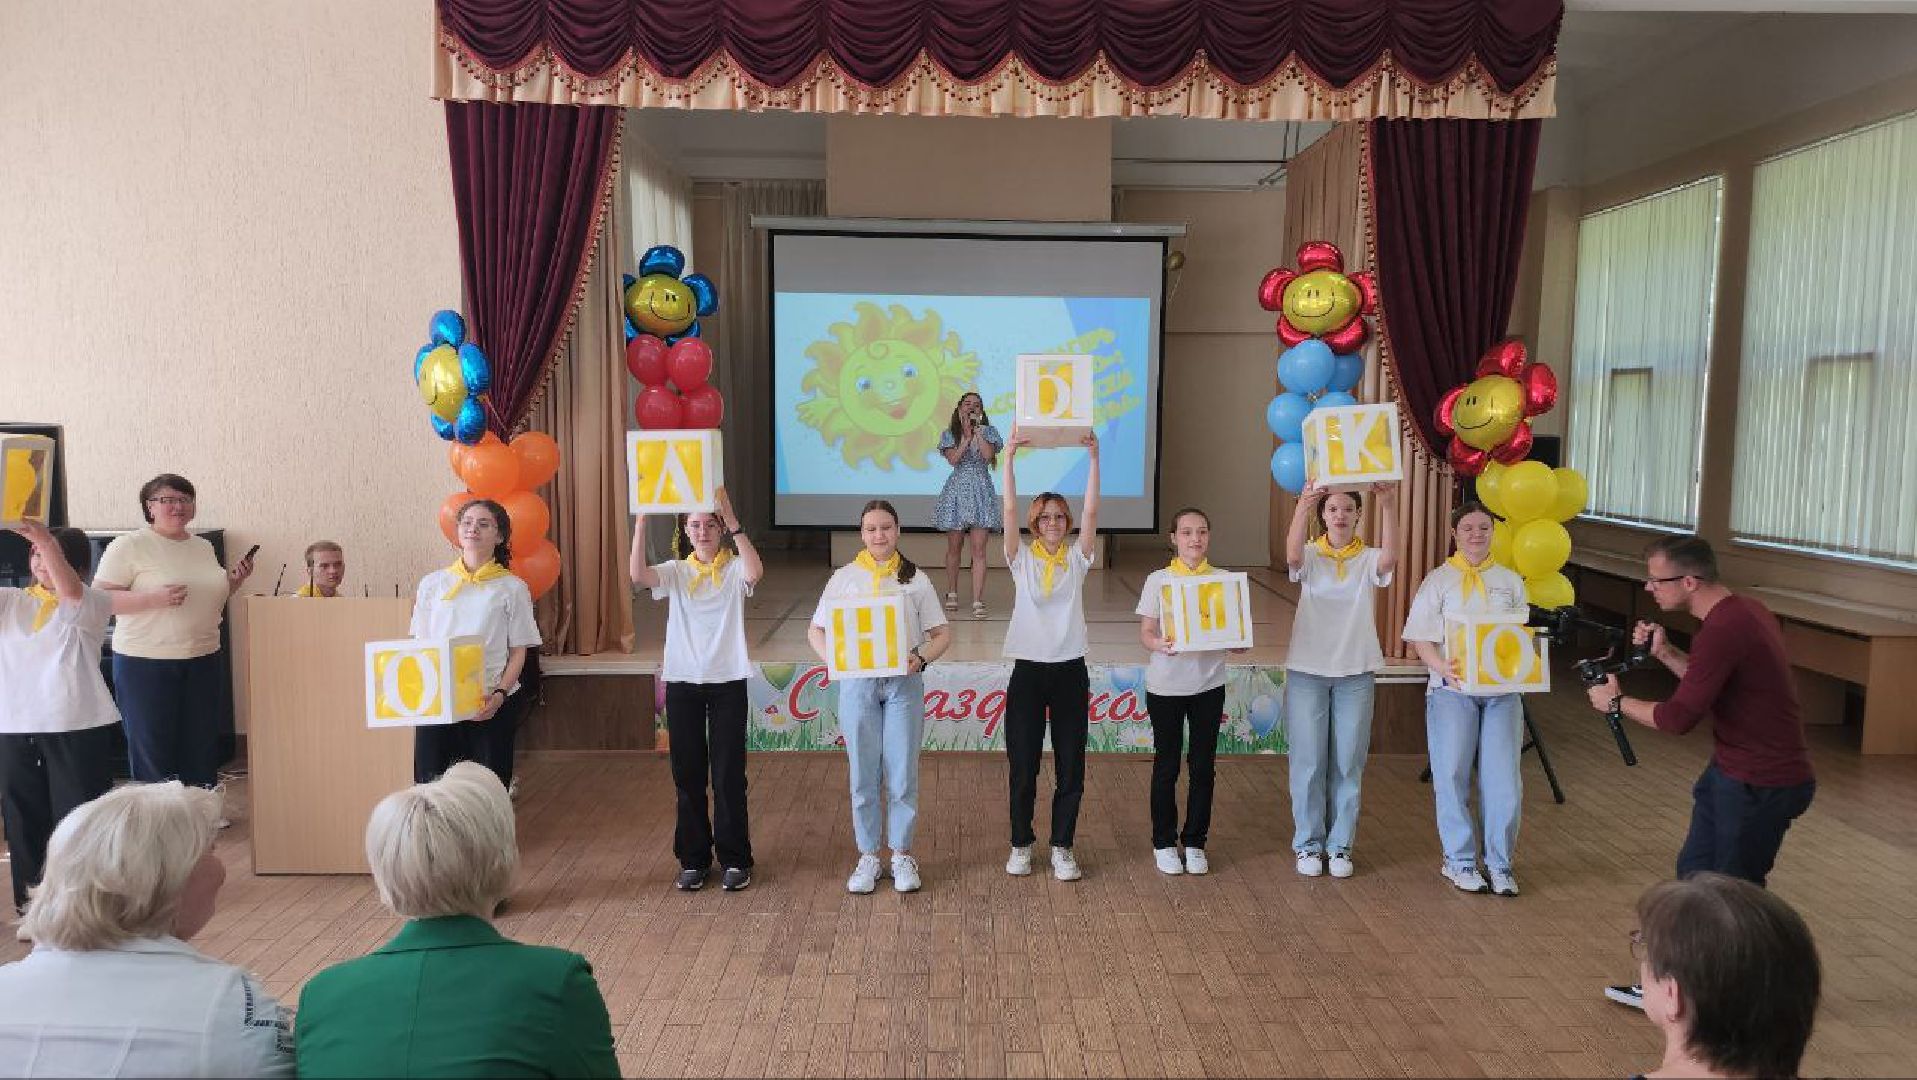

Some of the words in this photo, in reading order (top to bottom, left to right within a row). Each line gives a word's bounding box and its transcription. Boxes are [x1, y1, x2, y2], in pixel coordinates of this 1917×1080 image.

[1340, 411, 1390, 472] К
[843, 606, 888, 669] Н
[1481, 623, 1534, 684] О
[383, 649, 438, 717] О
[788, 665, 830, 721] С
